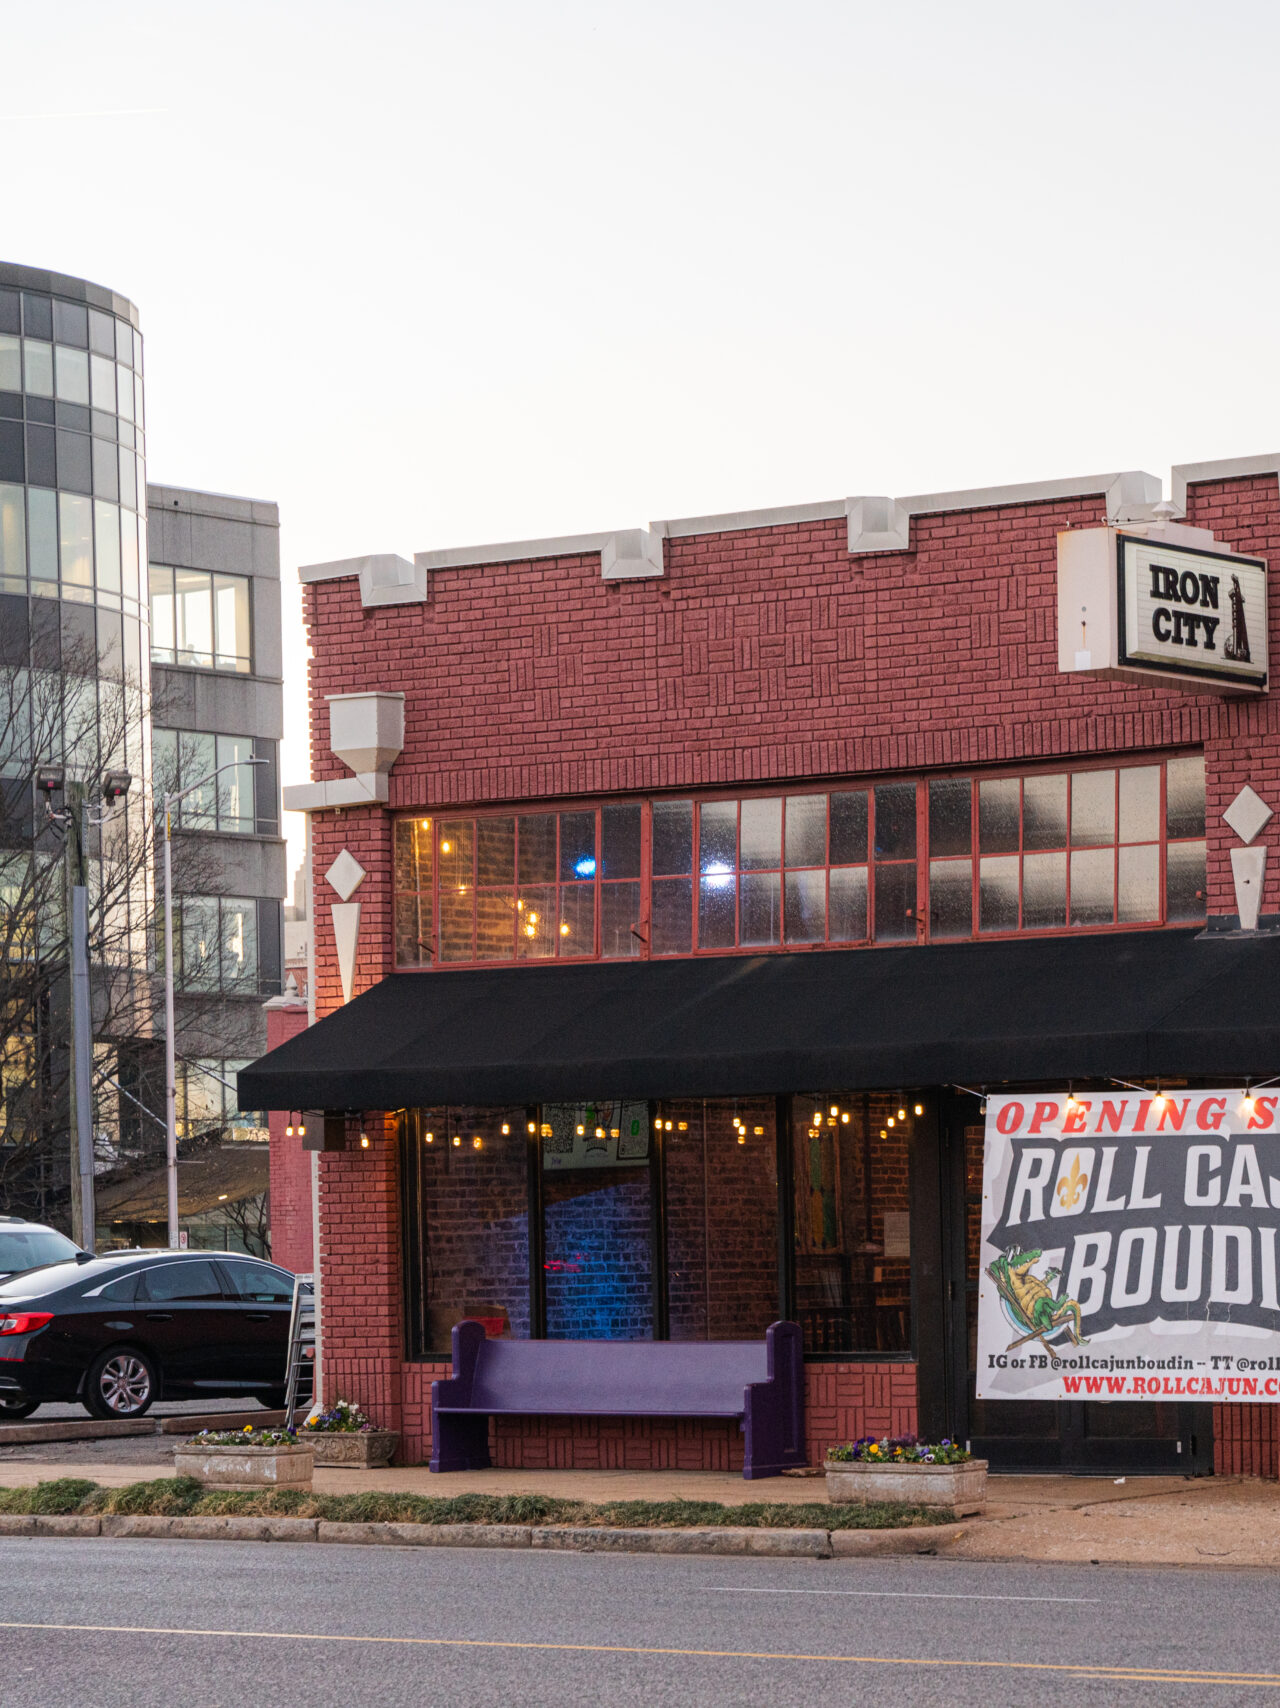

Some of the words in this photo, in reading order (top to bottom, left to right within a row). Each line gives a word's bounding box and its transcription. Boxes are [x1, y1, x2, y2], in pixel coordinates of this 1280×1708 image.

[1149, 564, 1220, 609] IRON
[1152, 607, 1220, 650] CITY
[996, 1097, 1227, 1134] OPENING
[1005, 1146, 1162, 1227] ROLL
[988, 1354, 1008, 1369] IG
[1011, 1358, 1025, 1369] or
[1029, 1354, 1048, 1369] FB
[1051, 1354, 1194, 1372] @rollcajunboudin
[1210, 1355, 1234, 1371] TT
